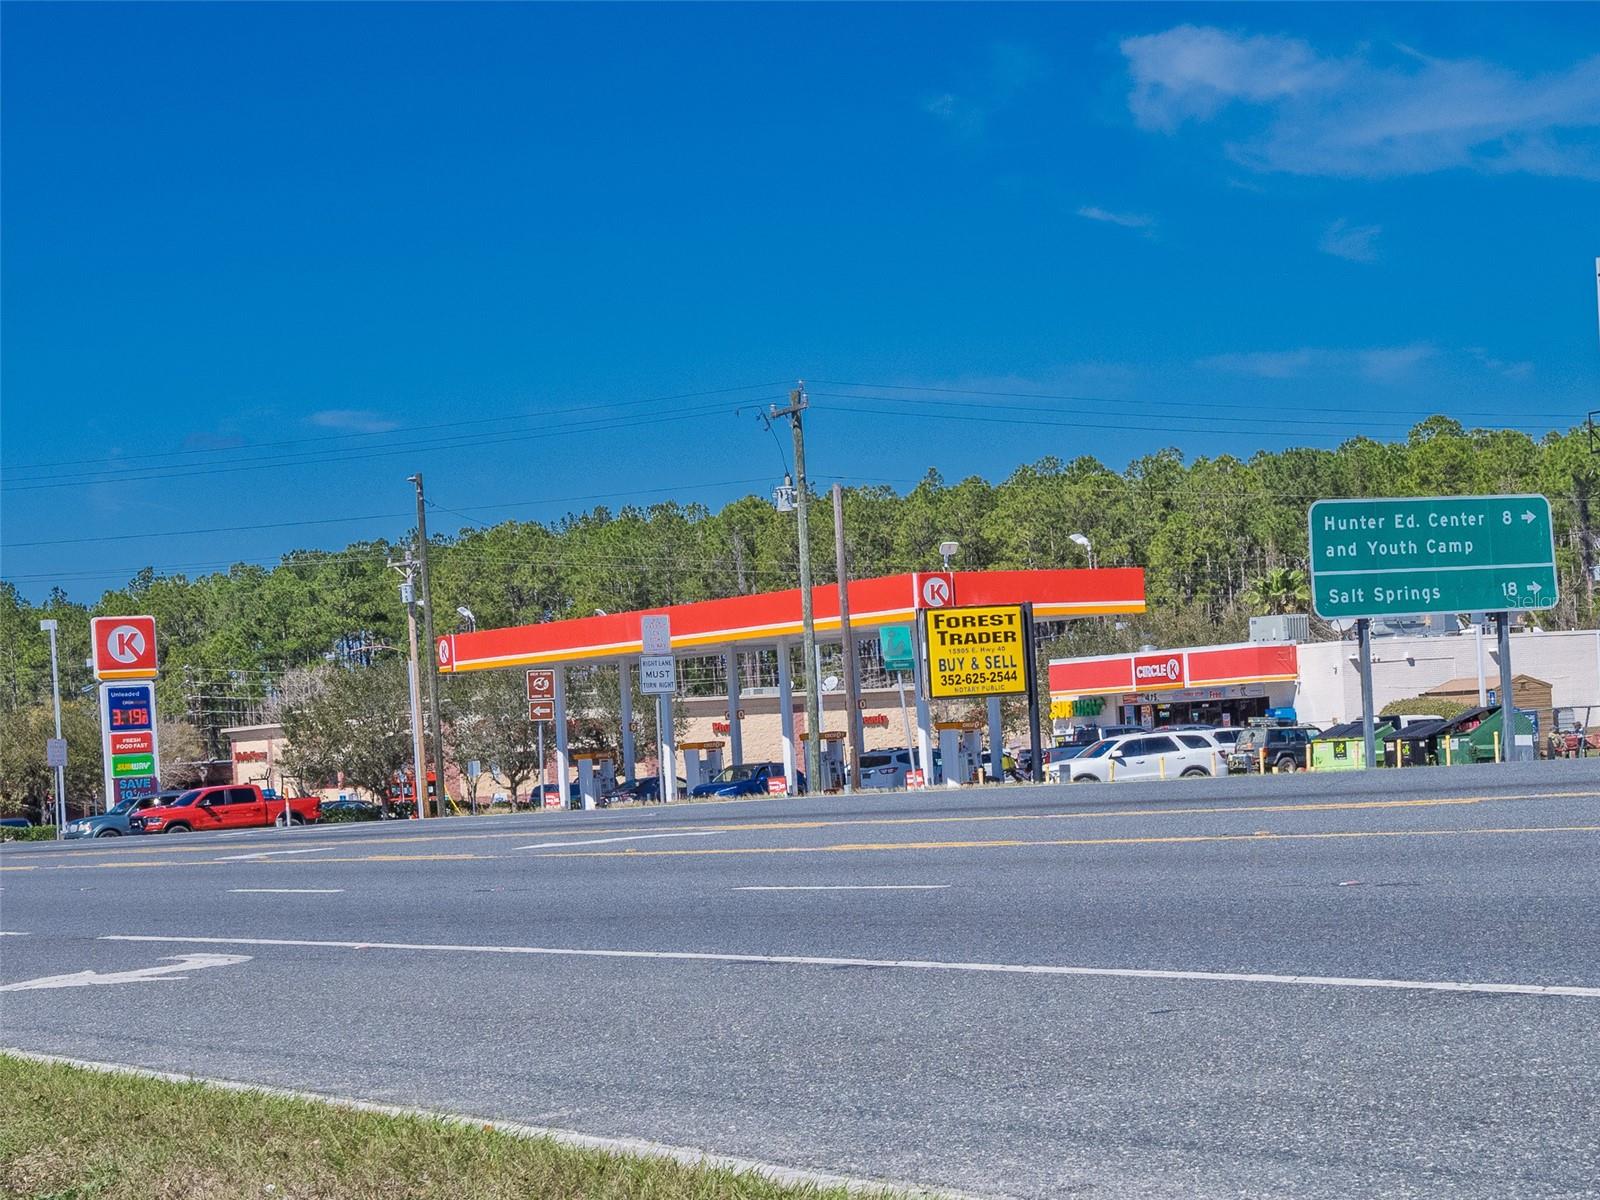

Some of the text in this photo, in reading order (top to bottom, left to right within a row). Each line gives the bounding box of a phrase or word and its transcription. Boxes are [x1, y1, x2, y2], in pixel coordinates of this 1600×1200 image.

[1324, 510, 1513, 530] Hunter Ed. Center 8
[1326, 538, 1474, 557] and Youth Camp
[926, 580, 948, 606] K
[1329, 581, 1518, 604] Salt Springs 18
[933, 613, 1017, 629] FOREST
[112, 627, 145, 662] K
[936, 630, 1017, 646] TRADER
[938, 654, 1017, 672] BUY & SELL
[1136, 660, 1179, 680] CIRCLE K
[645, 670, 670, 679] MUST
[940, 670, 1018, 687] 352-625-2544
[110, 690, 140, 698] Unleaded
[658, 681, 674, 689] RIGHT
[1049, 695, 1105, 720] SUBWAY
[119, 778, 151, 789] SAVE
